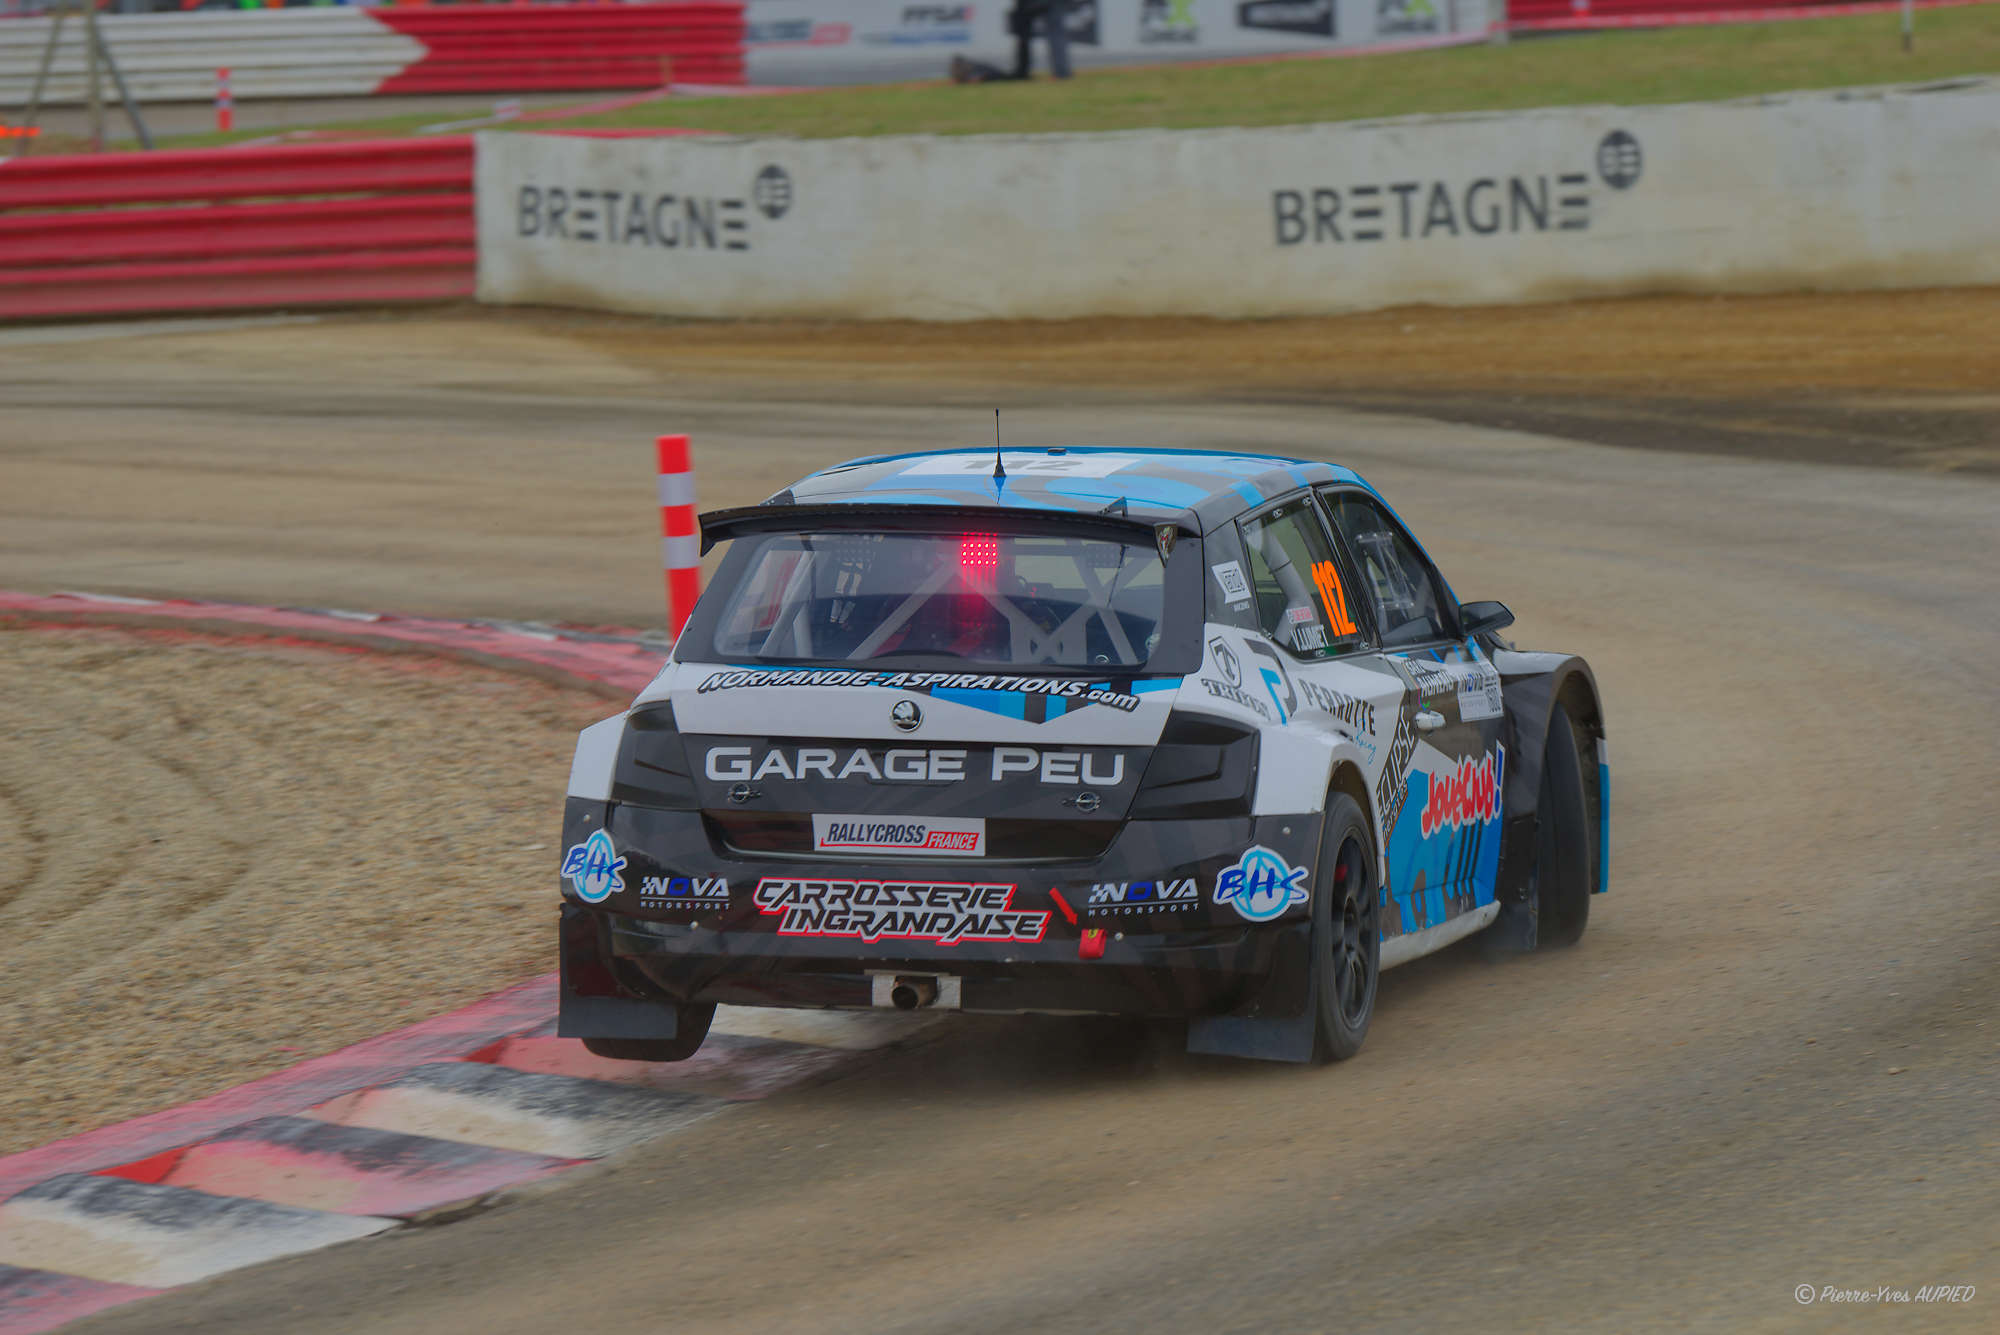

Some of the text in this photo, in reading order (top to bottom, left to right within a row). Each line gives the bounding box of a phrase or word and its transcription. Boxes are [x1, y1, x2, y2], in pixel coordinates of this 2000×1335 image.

[518, 186, 749, 251] BRETAGNE
[1273, 173, 1590, 246] BRETAGNE
[1311, 560, 1357, 637] 112
[698, 670, 1140, 712] NORMANDIE-ASPIRATIONS.com
[1297, 678, 1376, 737] PERROTTE
[705, 747, 1125, 786] GARAGE PEU
[827, 823, 979, 851] RALLYCROSS FRANCE
[640, 876, 730, 897] NOVA
[756, 881, 1009, 911] CARROSSERIE
[1088, 878, 1199, 904] NOVA
[1217, 868, 1307, 901] BHS
[640, 901, 731, 911] MOTORSPORT
[1088, 902, 1200, 917] MOTORSPORT
[783, 909, 1046, 941] INGRANDAISE
